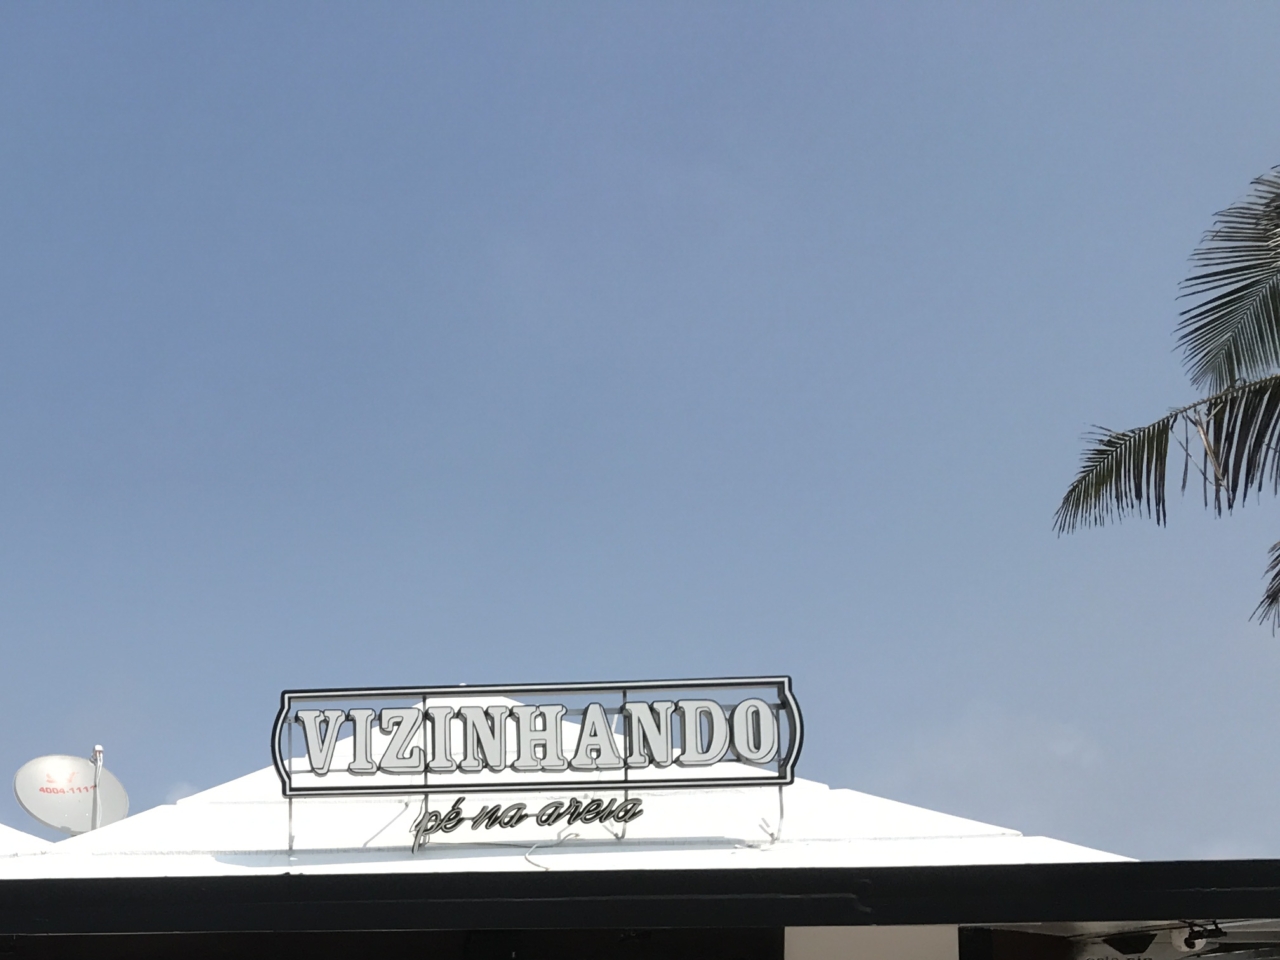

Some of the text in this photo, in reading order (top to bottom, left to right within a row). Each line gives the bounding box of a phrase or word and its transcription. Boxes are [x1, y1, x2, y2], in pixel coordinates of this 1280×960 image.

[297, 699, 778, 774] VIZINHANDO
[412, 797, 465, 853] pé
[471, 803, 528, 830] na
